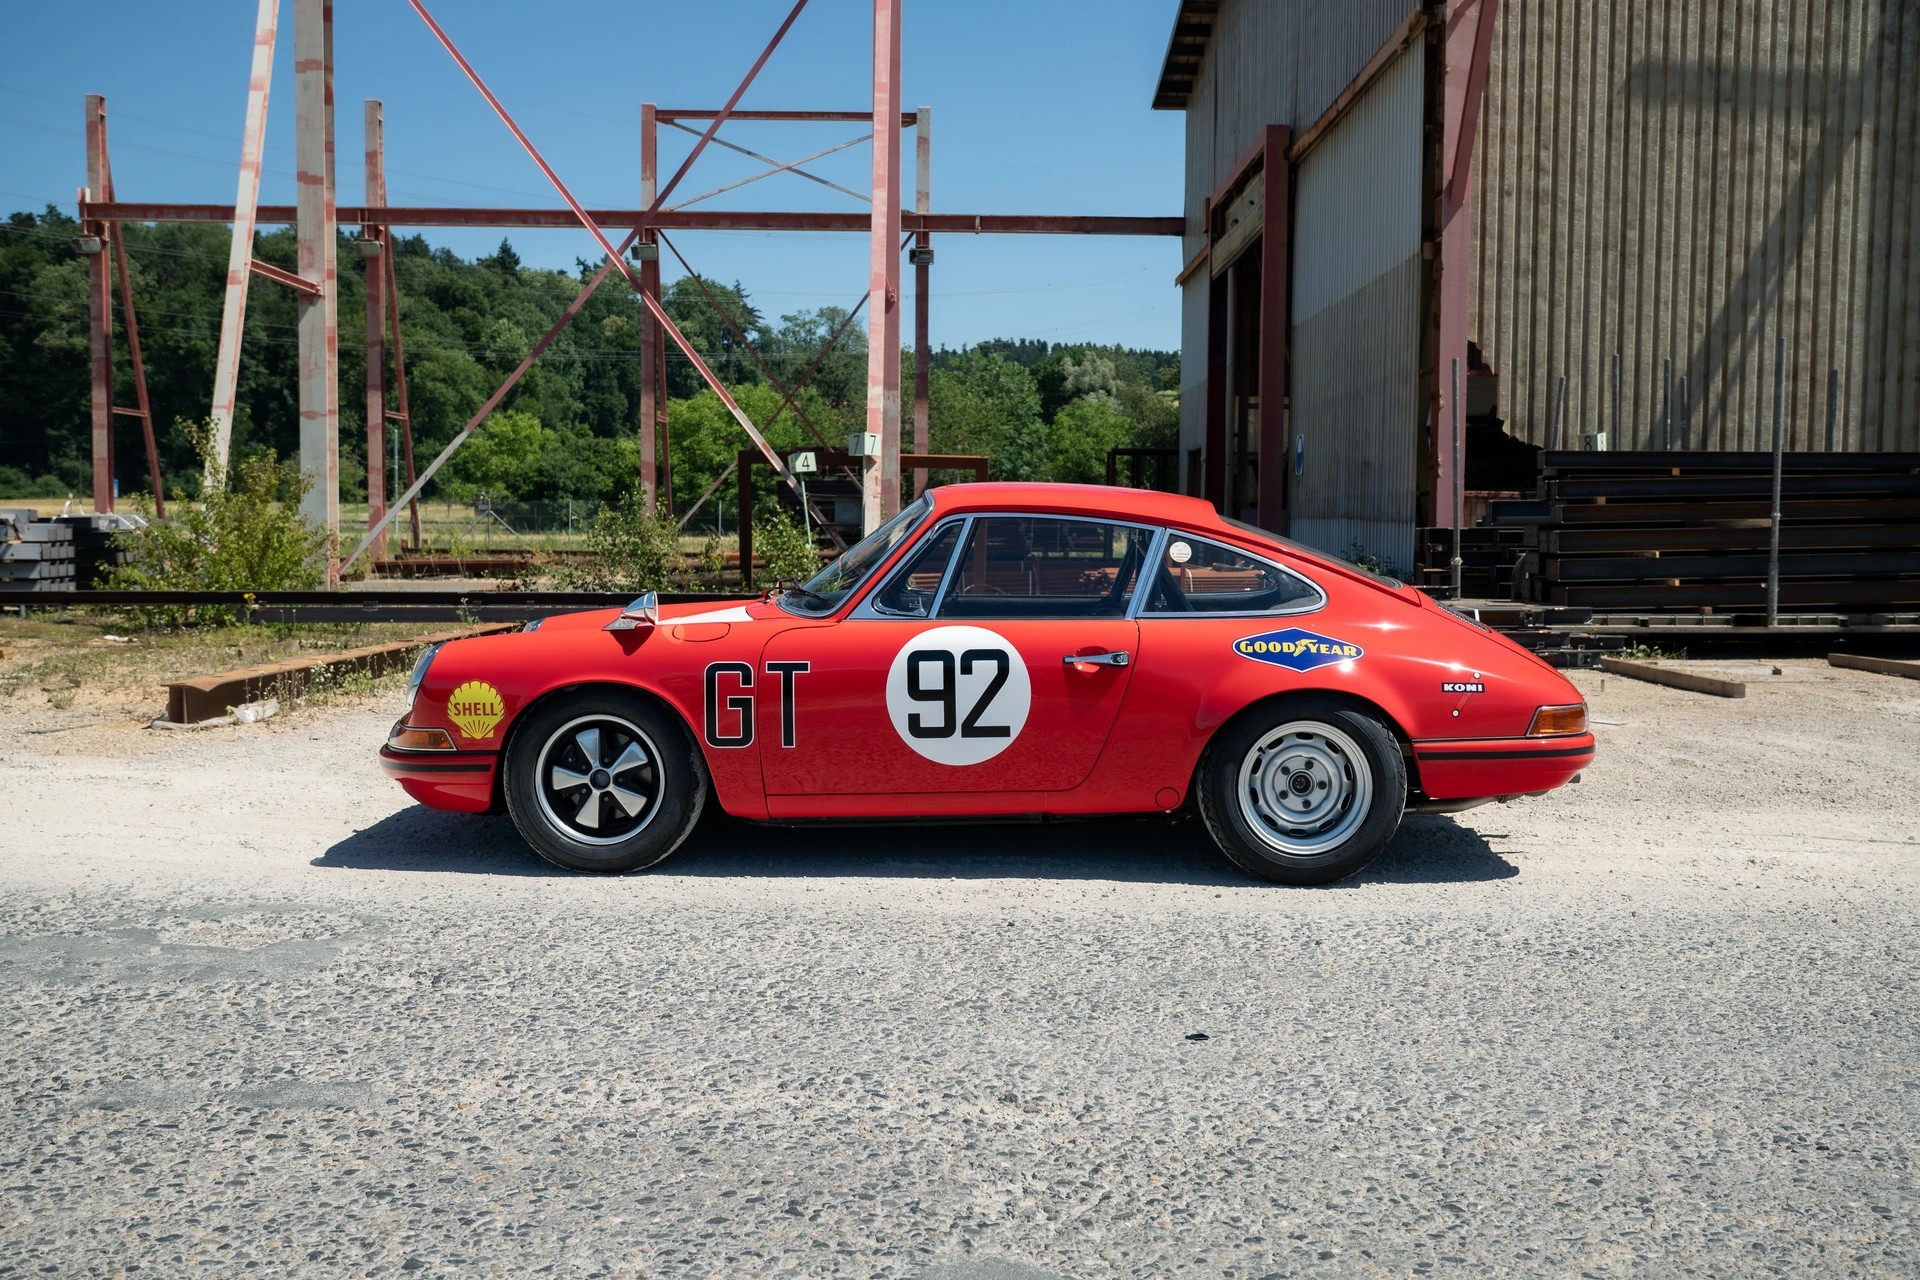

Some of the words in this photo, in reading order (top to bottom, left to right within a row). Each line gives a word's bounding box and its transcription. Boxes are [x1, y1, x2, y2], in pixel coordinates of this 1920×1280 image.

[853, 434, 861, 454] 7
[870, 434, 876, 454] 7
[1584, 435, 1592, 451] 8
[802, 454, 811, 471] 4
[906, 648, 1011, 739] 92
[1443, 683, 1483, 692] KONI
[453, 702, 498, 716] SHELL
[703, 660, 811, 749] GT
